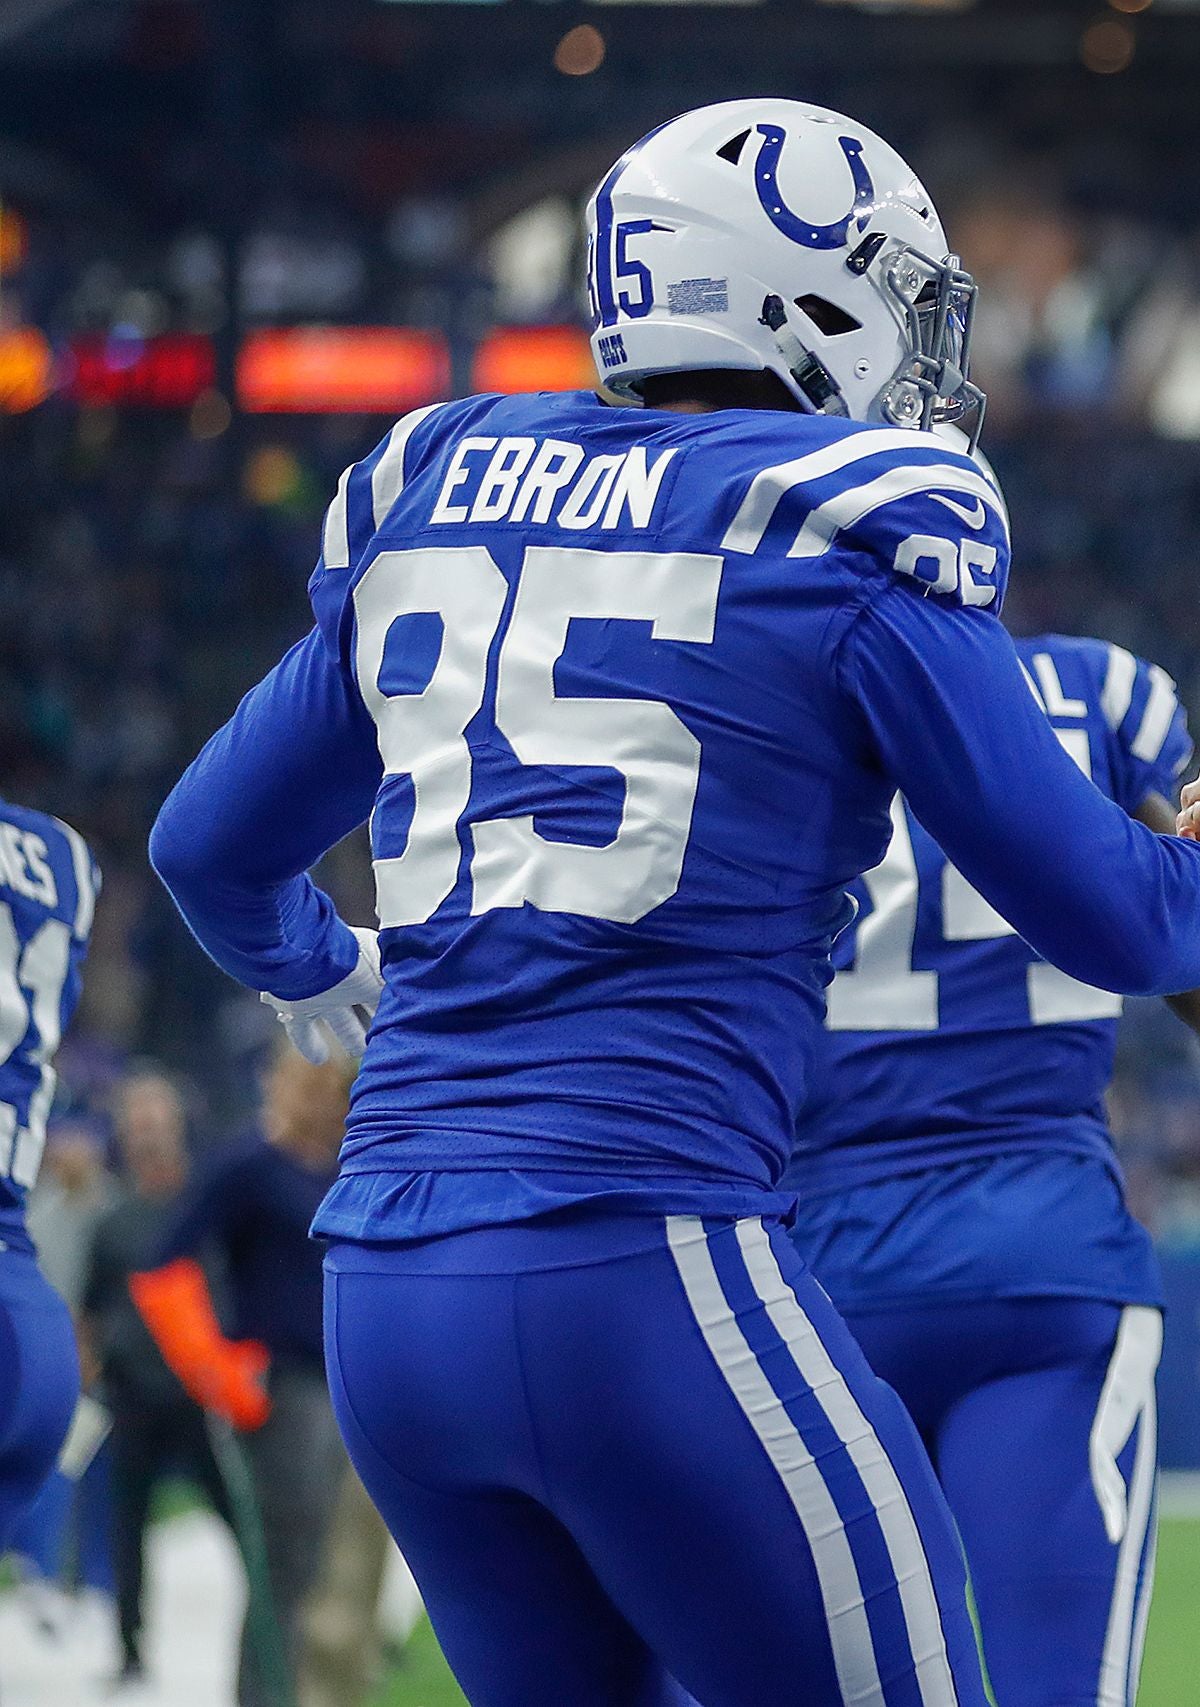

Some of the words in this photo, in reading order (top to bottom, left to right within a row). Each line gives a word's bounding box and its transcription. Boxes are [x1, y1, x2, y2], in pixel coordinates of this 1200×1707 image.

[588, 219, 654, 319] 5
[429, 437, 680, 530] EBRON
[352, 546, 724, 929] 85
